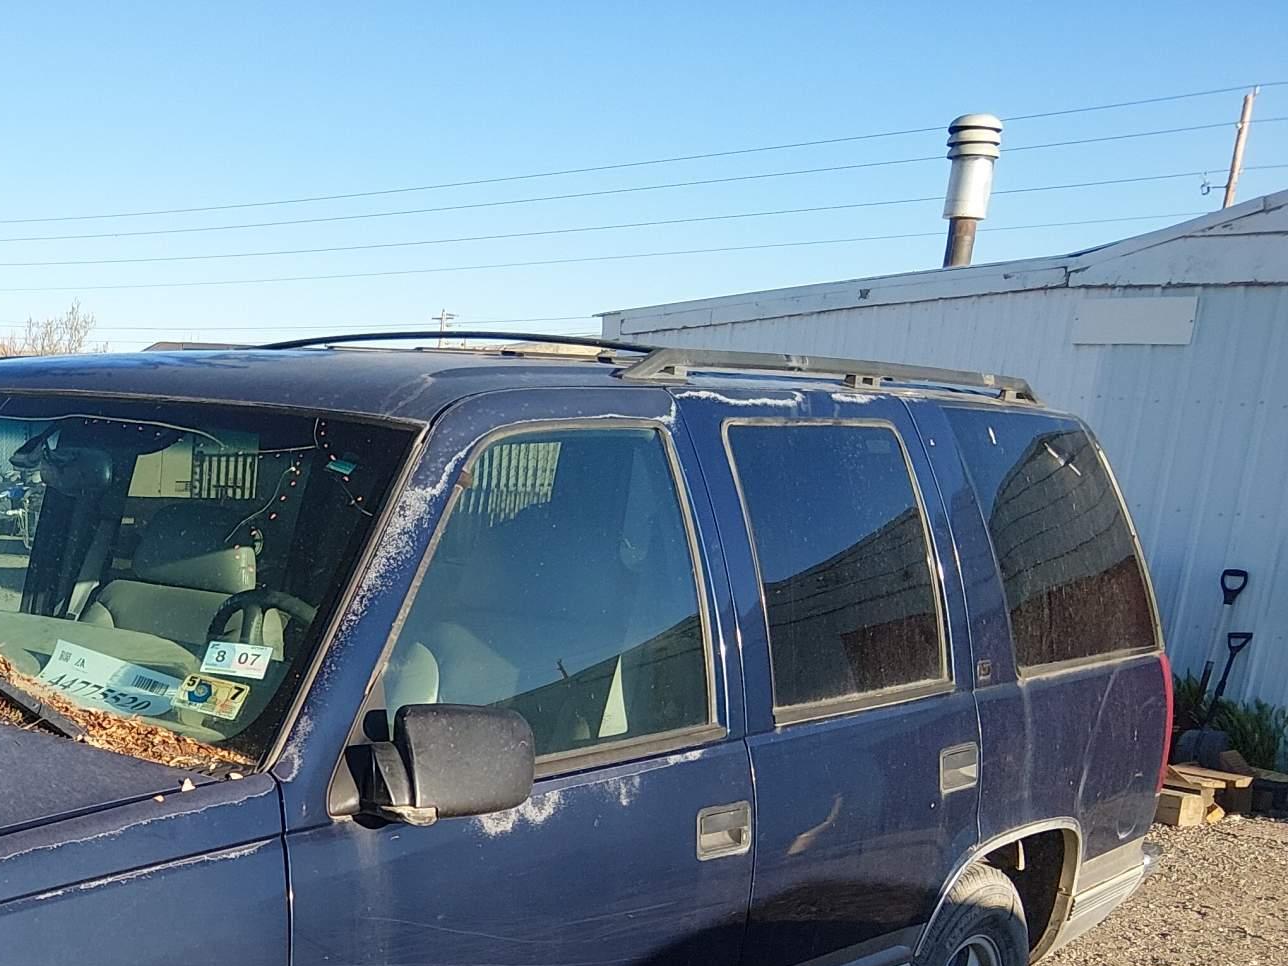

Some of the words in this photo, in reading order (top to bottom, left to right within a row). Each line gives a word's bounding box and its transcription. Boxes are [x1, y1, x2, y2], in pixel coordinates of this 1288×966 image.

[215, 650, 227, 663] 8
[237, 652, 262, 666] 07
[47, 673, 152, 712] 44775520
[186, 675, 198, 687] 5
[230, 686, 245, 701] 7
